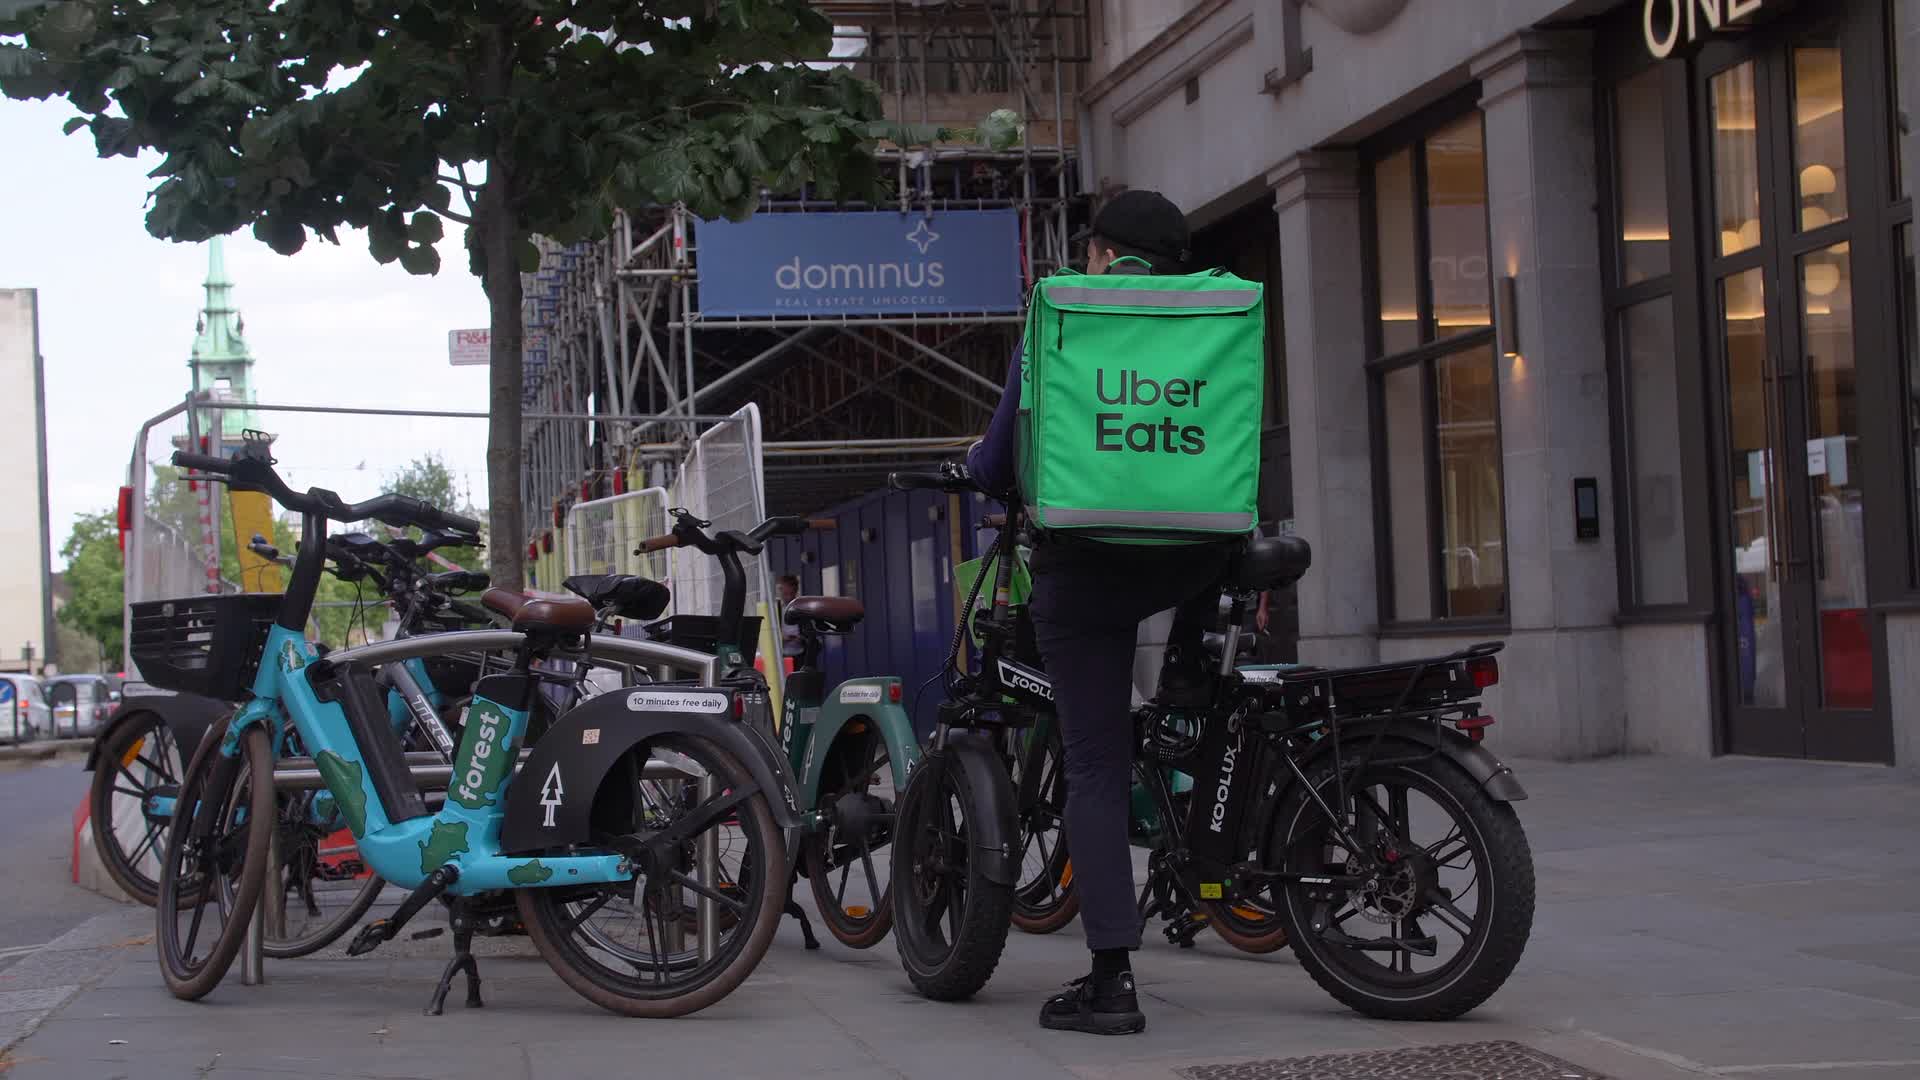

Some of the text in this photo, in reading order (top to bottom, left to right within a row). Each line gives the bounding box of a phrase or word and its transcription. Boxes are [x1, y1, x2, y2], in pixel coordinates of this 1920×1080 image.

[1644, 0, 1763, 58] ON
[775, 256, 945, 290] dominus
[1096, 368, 1208, 408] Uber
[1096, 413, 1206, 456] Eats
[633, 697, 722, 710] 10 minutes free daily
[1012, 674, 1055, 701] KOOLU
[782, 698, 796, 754] rest
[459, 711, 500, 800] forest
[1210, 745, 1238, 832] KOOLUX
